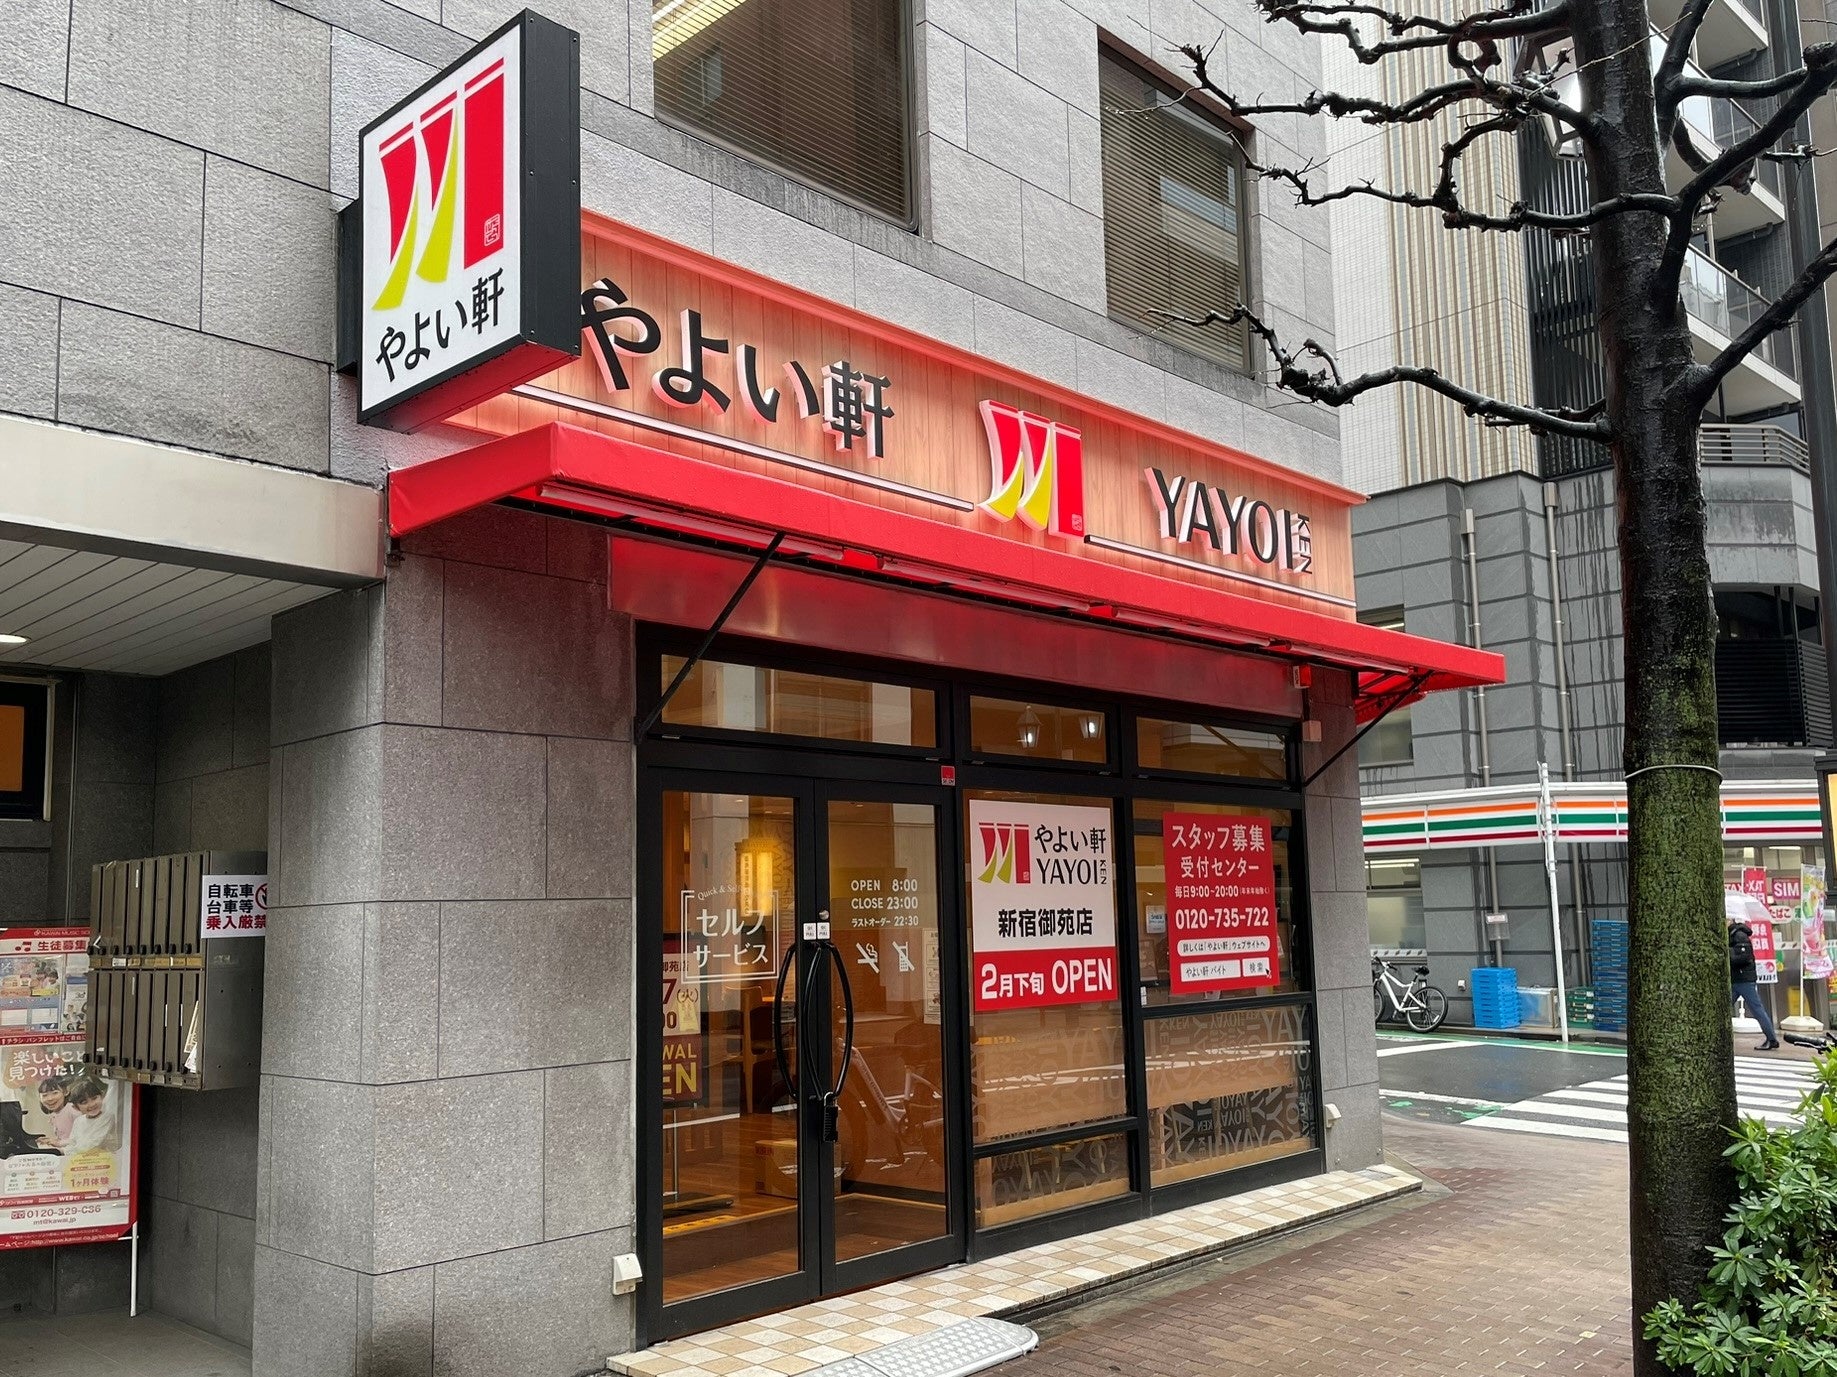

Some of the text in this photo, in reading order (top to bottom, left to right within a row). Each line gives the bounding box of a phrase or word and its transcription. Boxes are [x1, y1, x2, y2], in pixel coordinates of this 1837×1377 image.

[376, 268, 505, 382] やよい軒
[581, 277, 895, 460] やよい軒
[1147, 467, 1293, 570] YAYOI
[1298, 513, 1313, 574] KEN
[1035, 824, 1106, 854] やよい軒
[1172, 823, 1265, 852] スタッフ募集
[1036, 858, 1098, 885] YAYOI
[1181, 856, 1259, 878] 受付センター
[208, 884, 254, 898] 自転車
[851, 879, 917, 892] OPEN 8:00
[1774, 882, 1800, 897] SIM
[207, 900, 254, 914] 台車等
[851, 897, 918, 910] CLOSE 23:00
[206, 914, 266, 930] 乗入厳禁
[696, 908, 766, 937] セルフ
[851, 916, 919, 927] ラストオーダー 22:30
[998, 908, 1093, 938] 新宿御苑店
[1175, 907, 1269, 930] 0120-735-722
[38, 940, 86, 951] 生徒募集
[692, 943, 768, 968] サービス
[981, 963, 1044, 999] 2月下旬
[1052, 958, 1113, 995] OPEN
[13, 1050, 86, 1066] 楽しいこと
